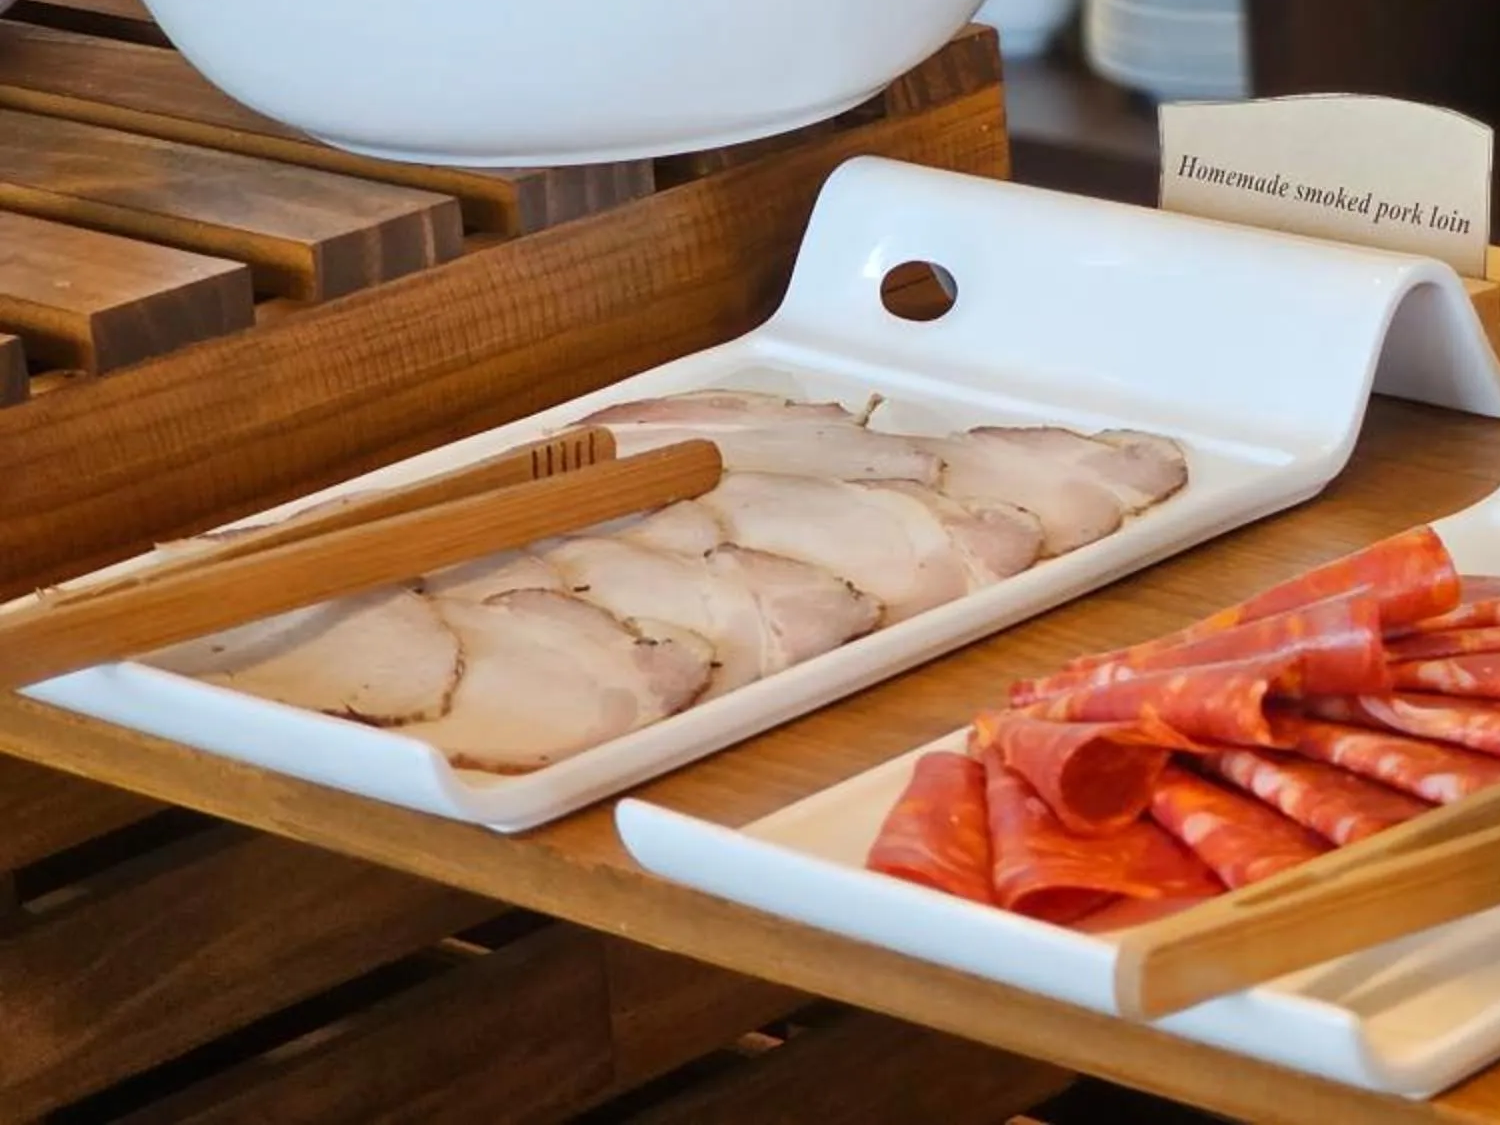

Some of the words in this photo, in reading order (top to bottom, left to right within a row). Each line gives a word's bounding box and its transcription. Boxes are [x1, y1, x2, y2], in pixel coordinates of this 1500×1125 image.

[1178, 154, 1289, 198] Homemade
[1294, 184, 1373, 215] smoked
[1373, 201, 1424, 225] pork
[1428, 205, 1471, 234] loin
